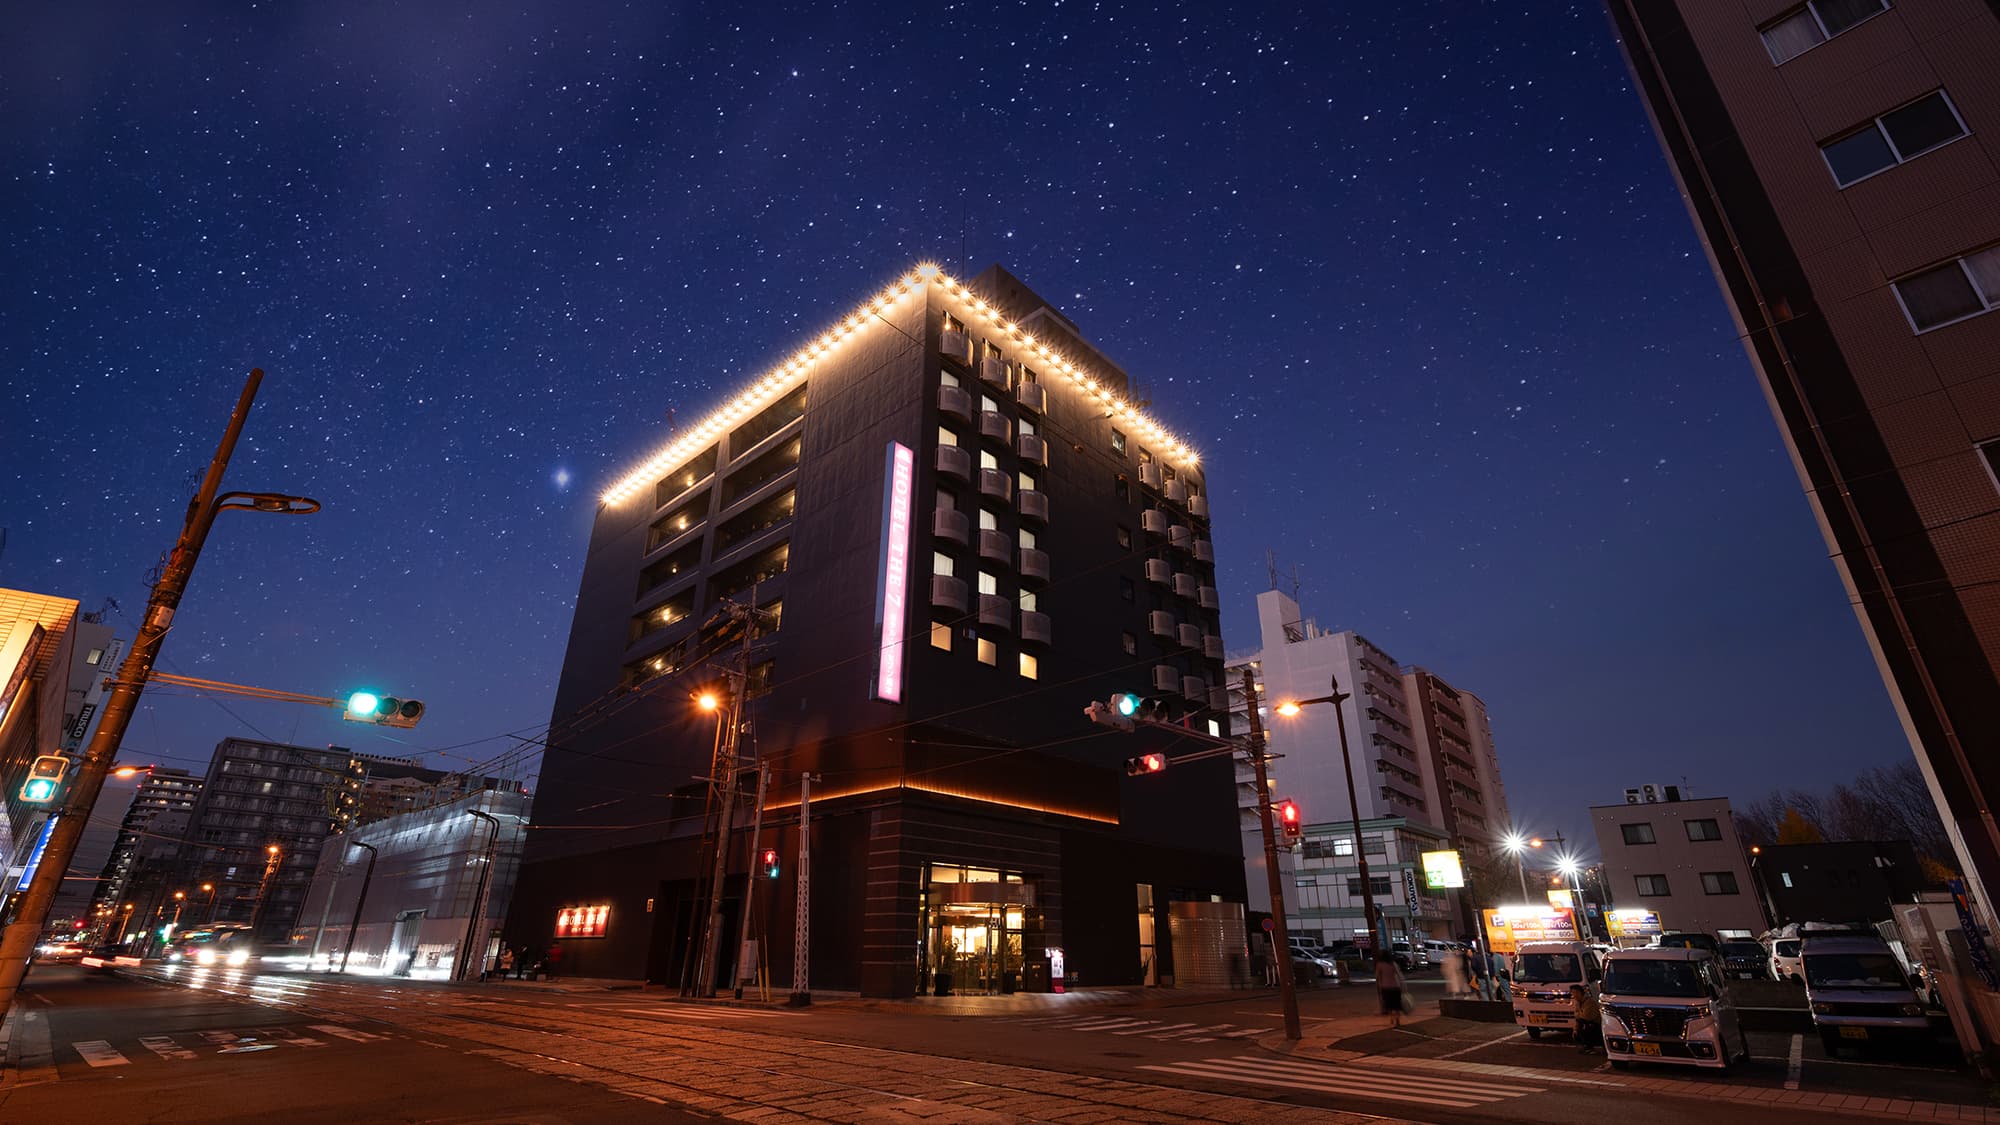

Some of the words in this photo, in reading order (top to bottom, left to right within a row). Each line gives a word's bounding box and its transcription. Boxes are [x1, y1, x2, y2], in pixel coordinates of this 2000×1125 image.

[892, 466, 908, 531] HOTEL
[889, 542, 906, 587] THE
[887, 594, 902, 611] 7
[73, 706, 94, 738] TRUSCO
[1406, 871, 1417, 903] KOKUYO
